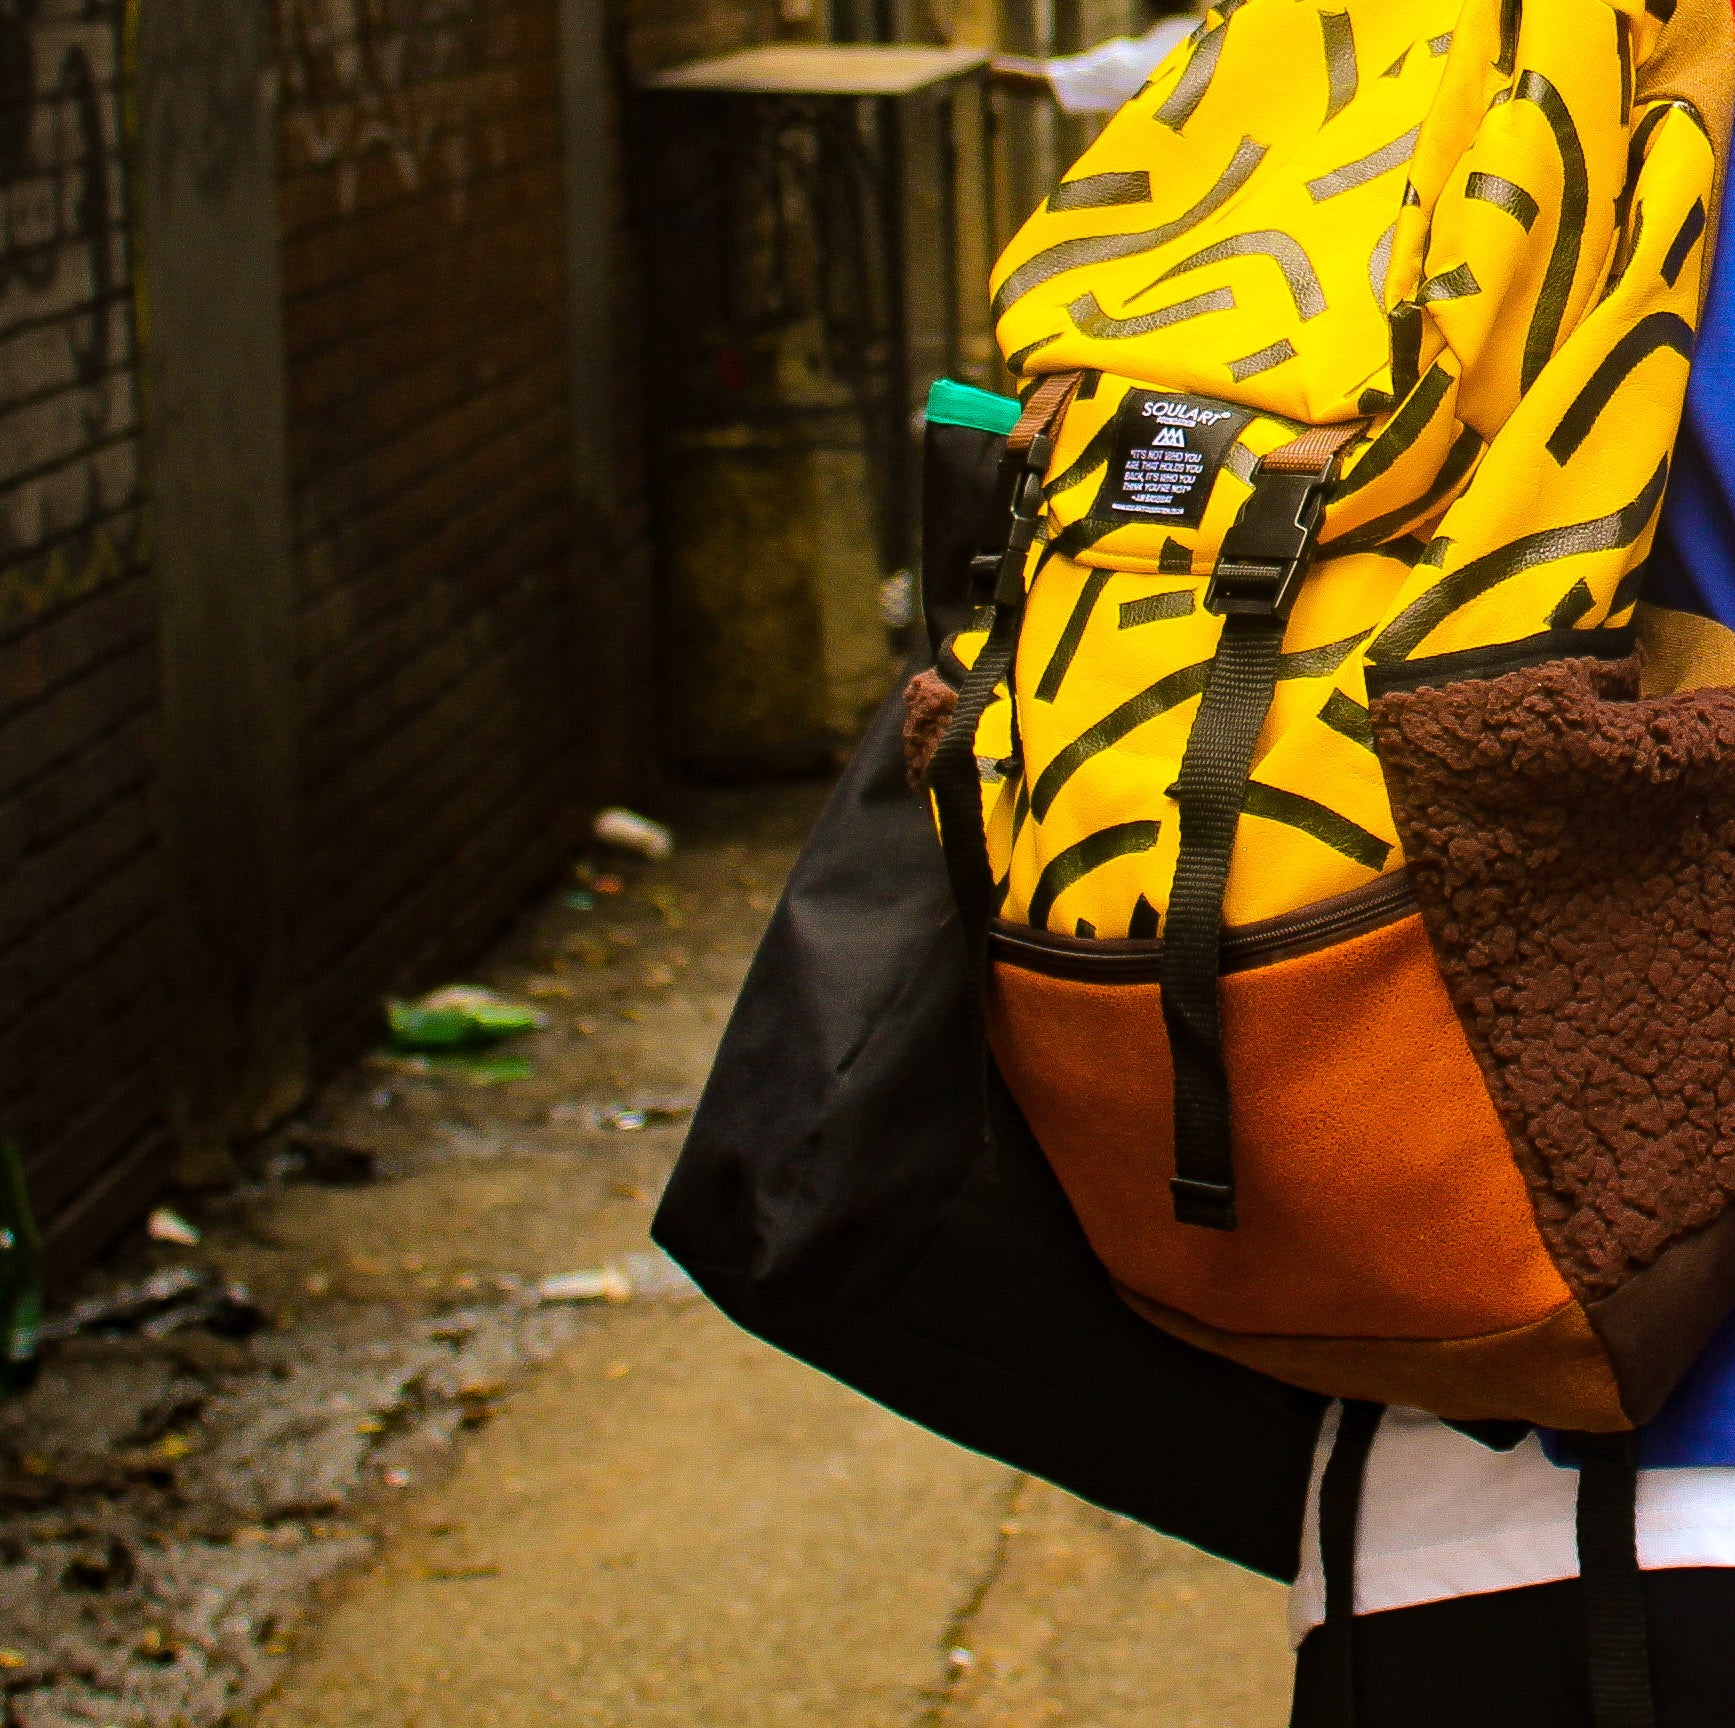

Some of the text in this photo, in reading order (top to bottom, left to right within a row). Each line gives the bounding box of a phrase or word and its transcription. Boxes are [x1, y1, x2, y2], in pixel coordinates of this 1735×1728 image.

[1147, 450, 1164, 460] NOT
[1184, 453, 1202, 463] YOU
[1185, 464, 1203, 474] YOU
[1179, 474, 1197, 484] YOU
